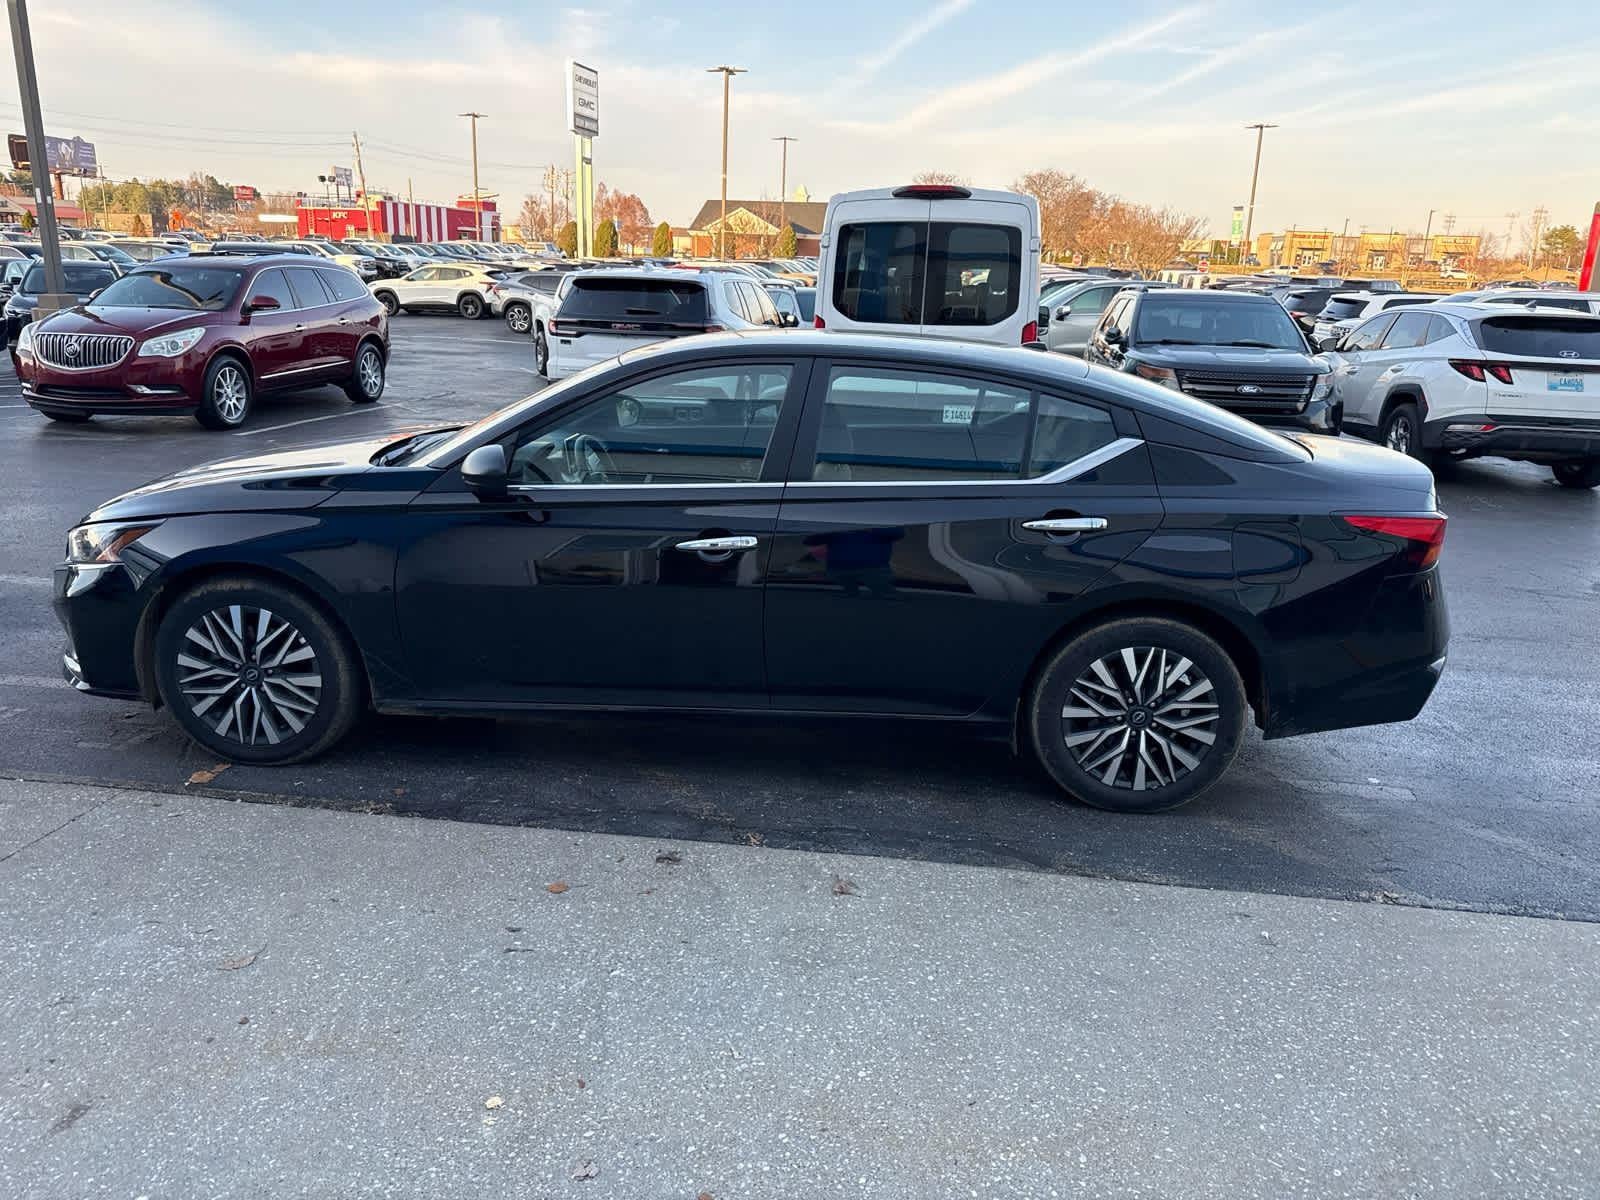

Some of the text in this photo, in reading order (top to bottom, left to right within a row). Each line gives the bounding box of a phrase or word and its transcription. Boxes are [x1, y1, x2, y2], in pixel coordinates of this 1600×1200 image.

[578, 97, 595, 112] GMC
[332, 211, 348, 219] KFC
[611, 323, 641, 331] GMC
